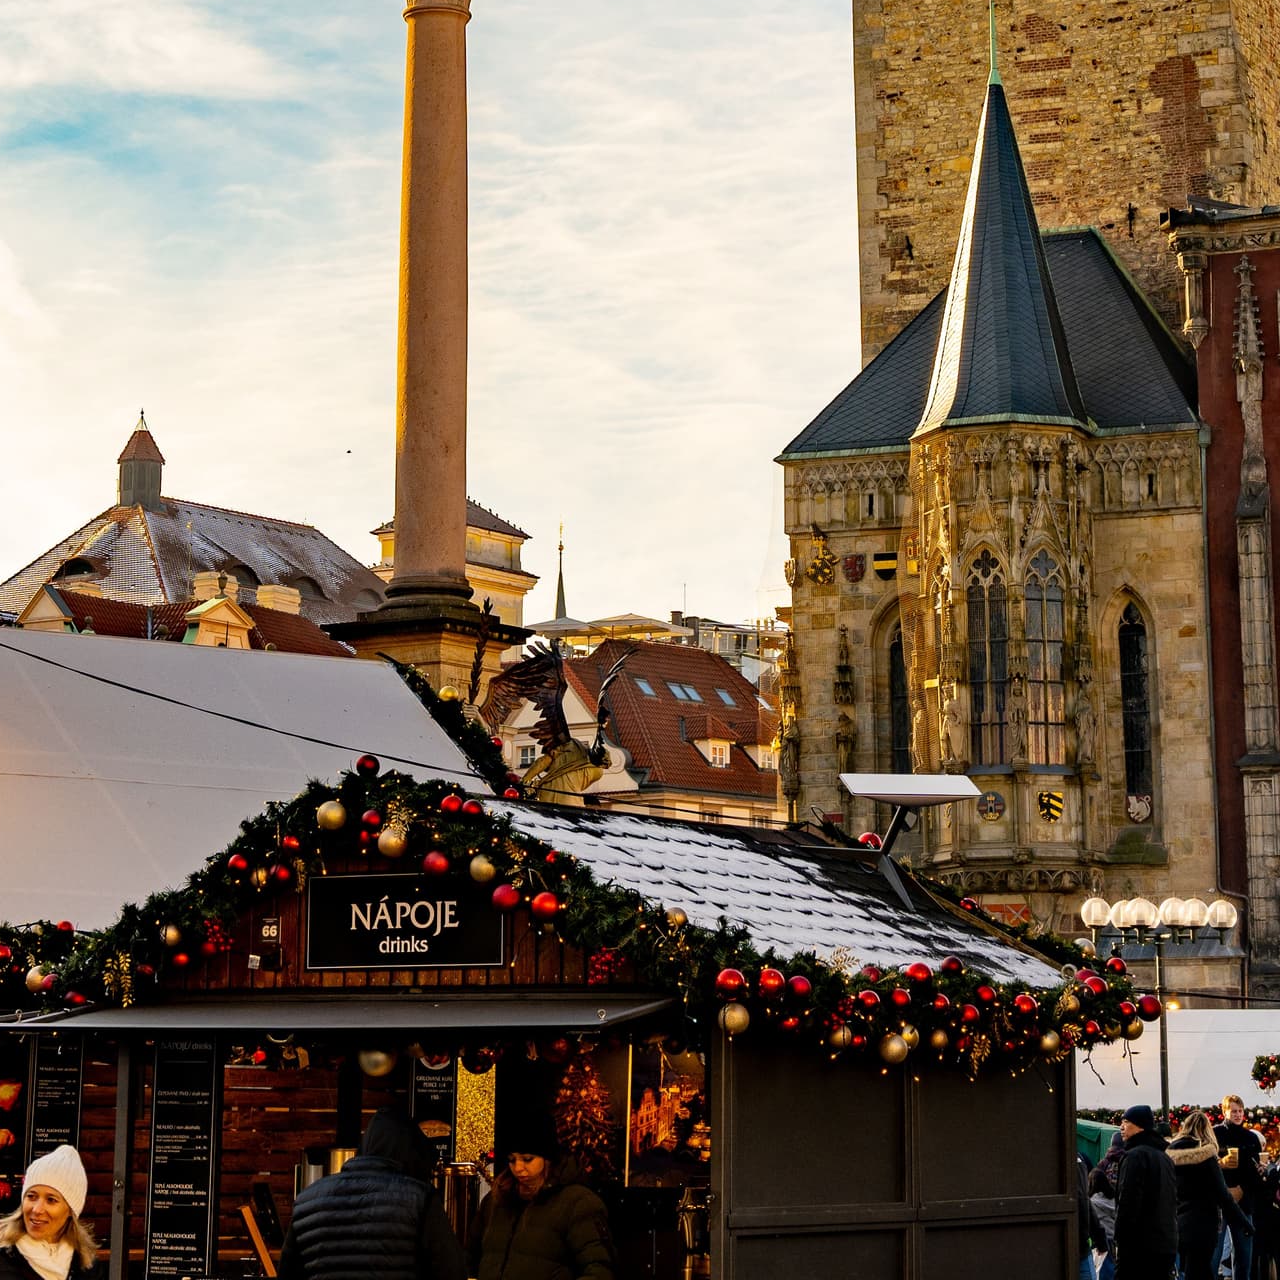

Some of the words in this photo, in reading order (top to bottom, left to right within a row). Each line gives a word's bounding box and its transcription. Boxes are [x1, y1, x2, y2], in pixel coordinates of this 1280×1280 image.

[350, 895, 459, 936] NÁPOJE
[262, 925, 277, 937] 66
[379, 936, 429, 953] drinks
